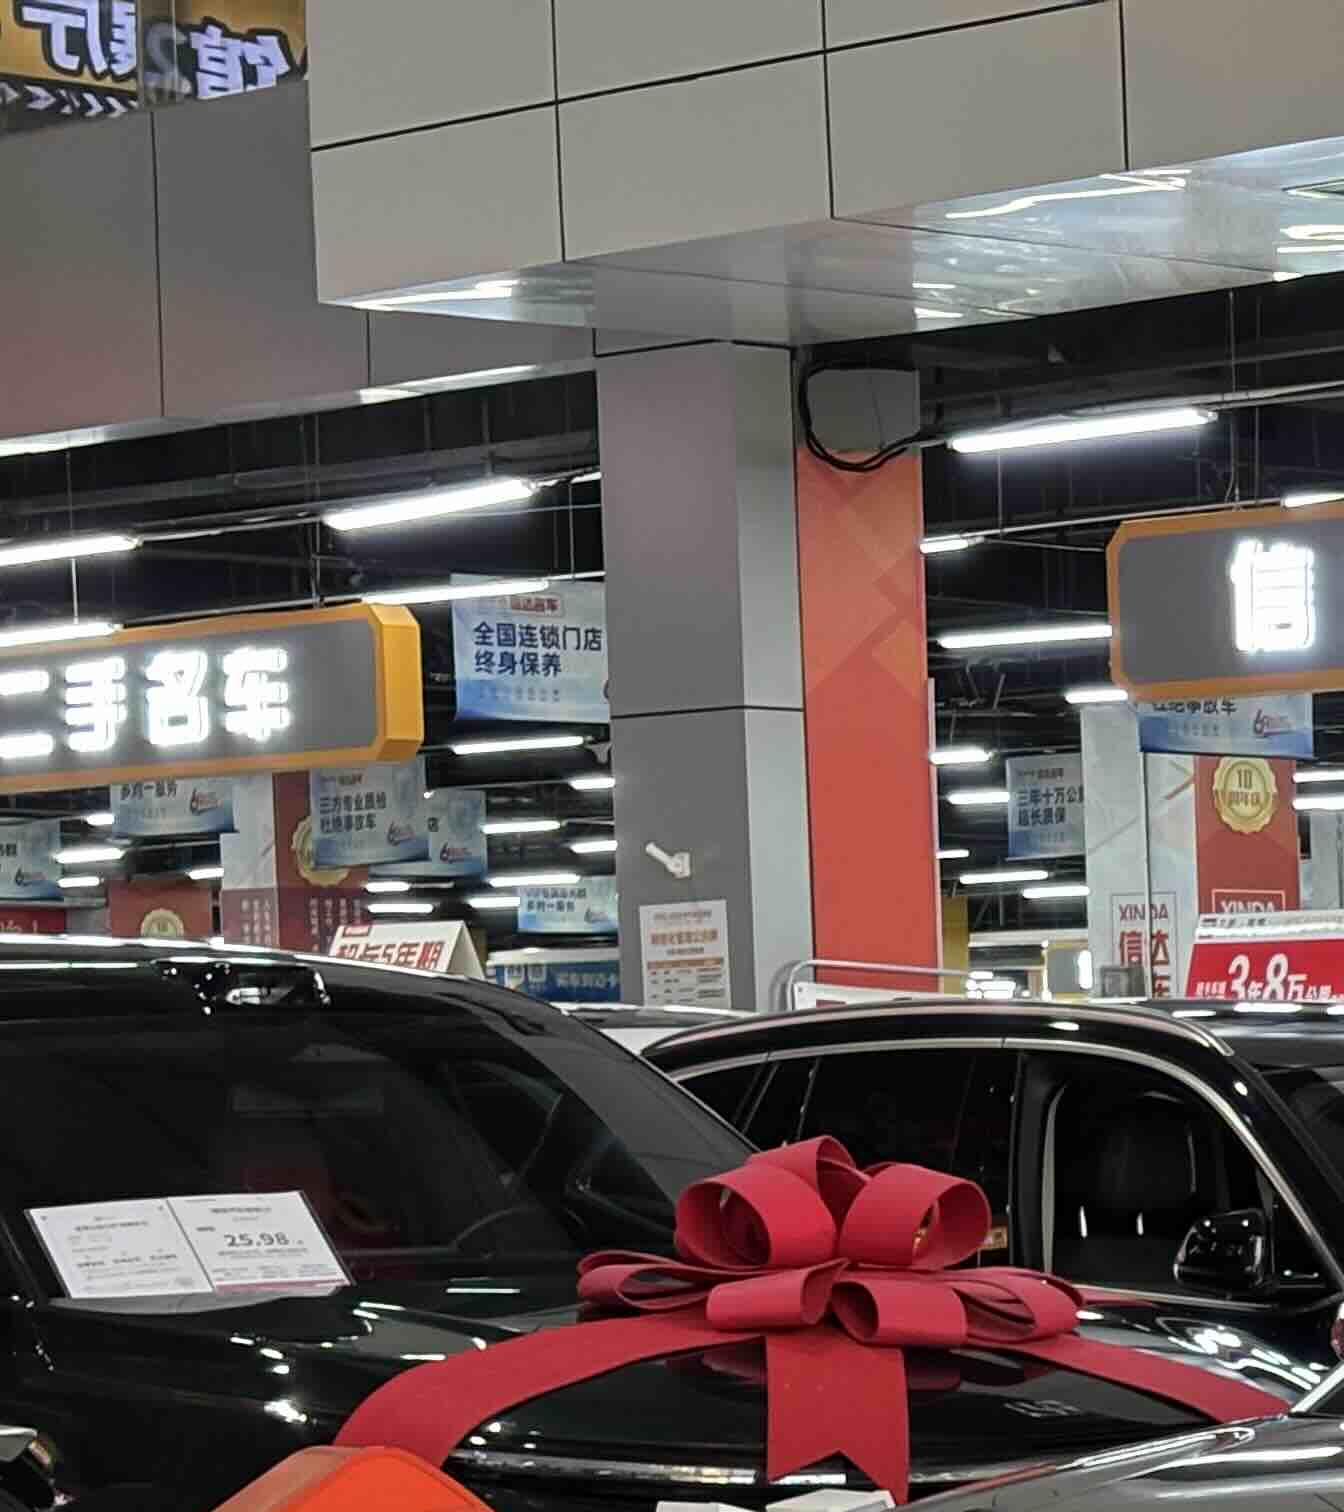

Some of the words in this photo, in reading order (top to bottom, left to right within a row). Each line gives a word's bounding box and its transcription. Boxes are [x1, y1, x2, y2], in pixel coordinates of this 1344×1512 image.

[474, 621, 603, 651] 全国连锁门店
[474, 650, 562, 677] 终身保养
[0, 646, 291, 758] 二手名车
